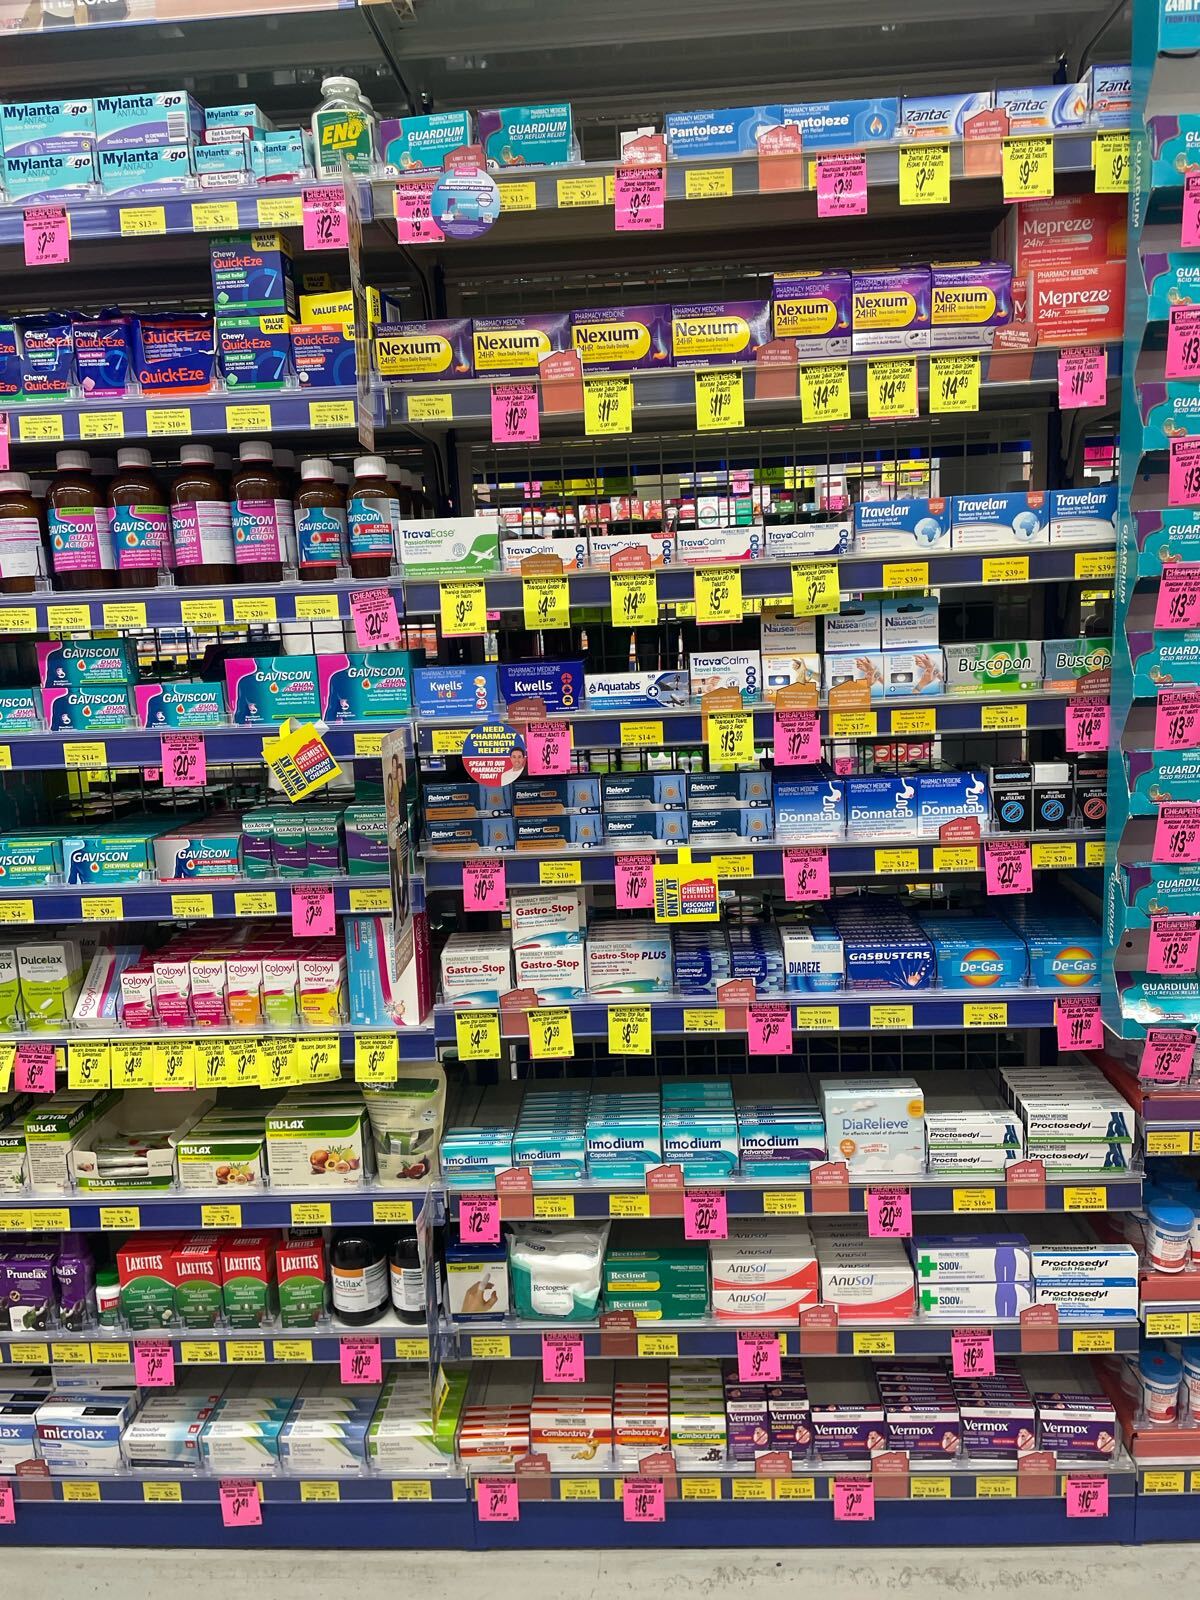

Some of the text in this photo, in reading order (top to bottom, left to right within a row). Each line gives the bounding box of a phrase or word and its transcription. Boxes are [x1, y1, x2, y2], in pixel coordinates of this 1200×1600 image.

[97, 95, 180, 113] Mylanta 2go
[1003, 99, 1047, 112] Zantac
[4, 103, 87, 120] Mylanta 2go
[117, 109, 148, 117] ANTACID
[906, 109, 950, 121] Zantac
[24, 115, 54, 124] ANTACID
[322, 121, 361, 145] ENO
[408, 126, 464, 141] GUARDIUM
[508, 122, 567, 134] GUARDIUM
[670, 125, 734, 138] Pantoleze
[409, 139, 422, 147] ACID
[445, 135, 463, 143] RELIEF
[103, 149, 186, 166] Mylanta 2go
[1023, 218, 1092, 236] Mepreze
[1023, 239, 1045, 248] 24hr
[776, 286, 803, 294] PHARMACY
[1039, 289, 1109, 307] Mepreze
[856, 309, 877, 318] 24HR
[935, 304, 956, 313] 24HR
[1039, 309, 1060, 318] 24hr
[575, 310, 625, 319] PHARMACY MEDICINE
[777, 317, 798, 325] 24HR
[675, 321, 739, 337] Nexium
[576, 328, 639, 344] Nexium
[477, 335, 539, 350] Nexium
[24, 374, 48, 382] Chewy
[957, 498, 1007, 512] Travelan
[1056, 493, 1106, 506] Travelan
[860, 504, 909, 518] Travelan
[402, 529, 454, 538] TravaEase
[680, 537, 725, 546] TravaCalm
[507, 546, 554, 555] TravaCalm
[693, 656, 749, 667] TravaCalm
[958, 657, 1032, 673] Buscopan
[255, 671, 312, 682] GAVISCON
[430, 682, 463, 692] Kwells
[515, 681, 552, 692] Kwells
[597, 682, 641, 695] Aquatabs
[68, 694, 126, 705] GAVISCON
[163, 693, 217, 702] GAVISCON
[304, 758, 331, 777] DISCOUNT
[309, 765, 332, 781] CHEMIST
[851, 809, 913, 819] Donnatab
[921, 803, 984, 815] Donnatab
[779, 812, 841, 823] Donnatab
[103, 862, 128, 870] CHEWING
[682, 886, 715, 895] CHEMIST
[655, 879, 665, 918] AVAILABLE
[667, 879, 678, 917] ONLY AT
[20, 955, 62, 965] Dulcolax
[590, 951, 667, 960] Gastro-Stop PLUS
[848, 950, 931, 961] GASBUSTERS
[229, 964, 259, 976] Coloxyl
[446, 965, 505, 974] Gastro-Stop
[789, 962, 821, 974] DIAREZE
[960, 961, 1004, 973] De-Gas
[1052, 960, 1097, 971] De-Gas
[156, 967, 186, 979] Coloxyl
[192, 966, 223, 979] Coloxyl
[1142, 983, 1199, 991] GUARDIUM
[842, 1118, 908, 1131] DiaRelieve
[1030, 1122, 1091, 1130] Proctosedyl
[588, 1137, 645, 1150] Imodium
[665, 1138, 721, 1149] Imodium
[445, 1156, 488, 1165] Imodium
[126, 1255, 163, 1272] LAXETTES
[176, 1261, 214, 1276] LAXETTES
[225, 1256, 262, 1272] LAXETTES
[728, 1263, 767, 1274] AnuSol
[1041, 1259, 1109, 1267] Proctosedyl
[7, 1269, 47, 1279] Prunelax
[335, 1279, 361, 1288] Actilax
[533, 1284, 569, 1292] Rectogesic
[728, 1292, 767, 1304] AnuSol
[1040, 1290, 1108, 1298] Proctosedyl
[613, 1300, 648, 1308] Rectinol
[729, 1413, 764, 1422] Vermox
[771, 1412, 806, 1421] Vermox
[43, 1428, 104, 1439] microlax
[815, 1425, 859, 1435] Vermox
